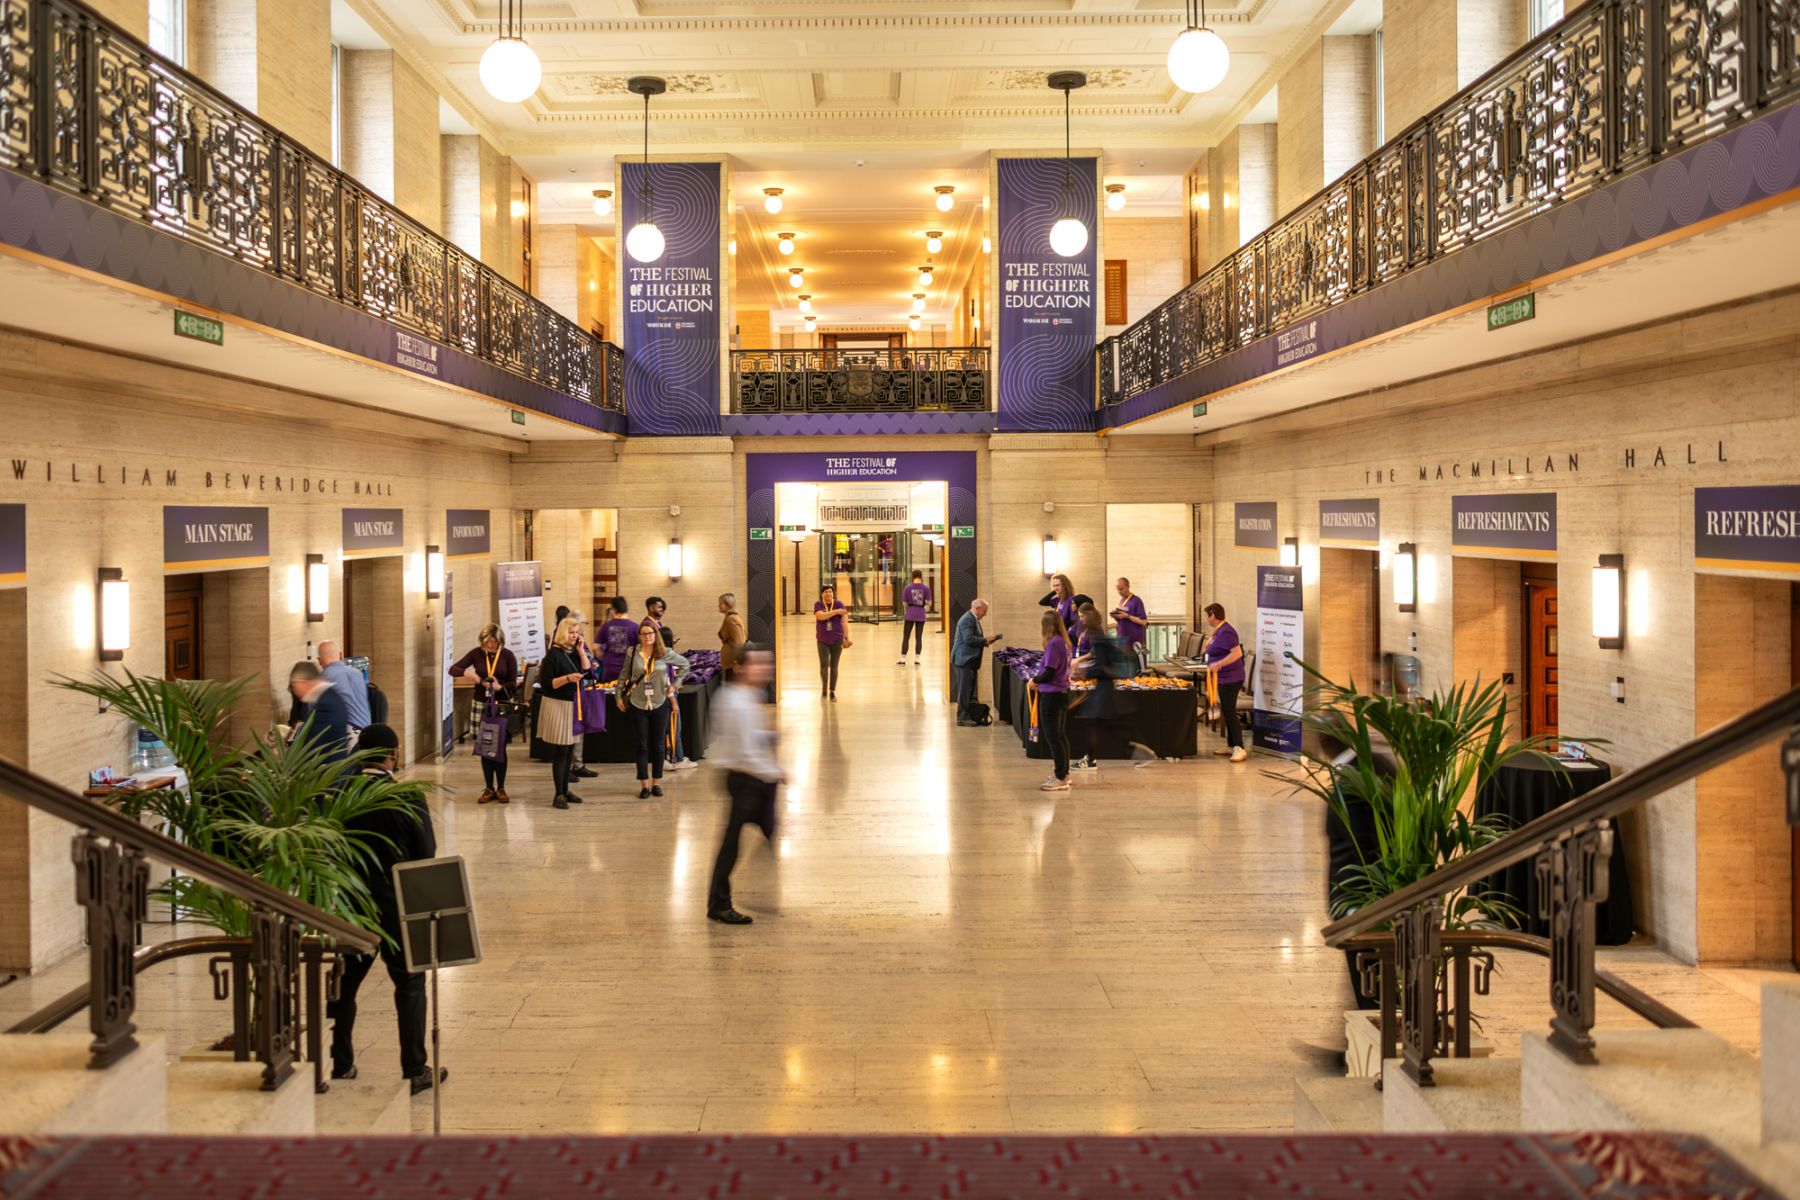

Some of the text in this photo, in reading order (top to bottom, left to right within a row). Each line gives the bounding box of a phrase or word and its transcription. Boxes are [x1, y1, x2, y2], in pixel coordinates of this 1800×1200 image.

[630, 267, 712, 280] THE FESTIVAL
[1005, 263, 1090, 276] THE FESTIVAL
[630, 284, 712, 296] OF HIGHER
[1006, 280, 1090, 292] OF HIGHER
[630, 299, 712, 312] EDUCATION
[1005, 295, 1090, 308] EDUCATION
[396, 332, 412, 352] THE
[1278, 332, 1290, 352] THE
[826, 458, 896, 468] THE FESTIVAL OF
[1366, 440, 1727, 484] THE MACMILLAN HALL
[12, 460, 392, 496] WILLIAM BEVERIDGE HALL
[1240, 518, 1272, 531] REGISTRATION
[1322, 512, 1376, 528] REFRESHMENTS
[1458, 512, 1550, 532] REFRESHMENTS
[185, 524, 254, 544] MAIN STAGE
[354, 522, 394, 536] MAIN STAGE
[452, 525, 485, 538] INFORMATION
